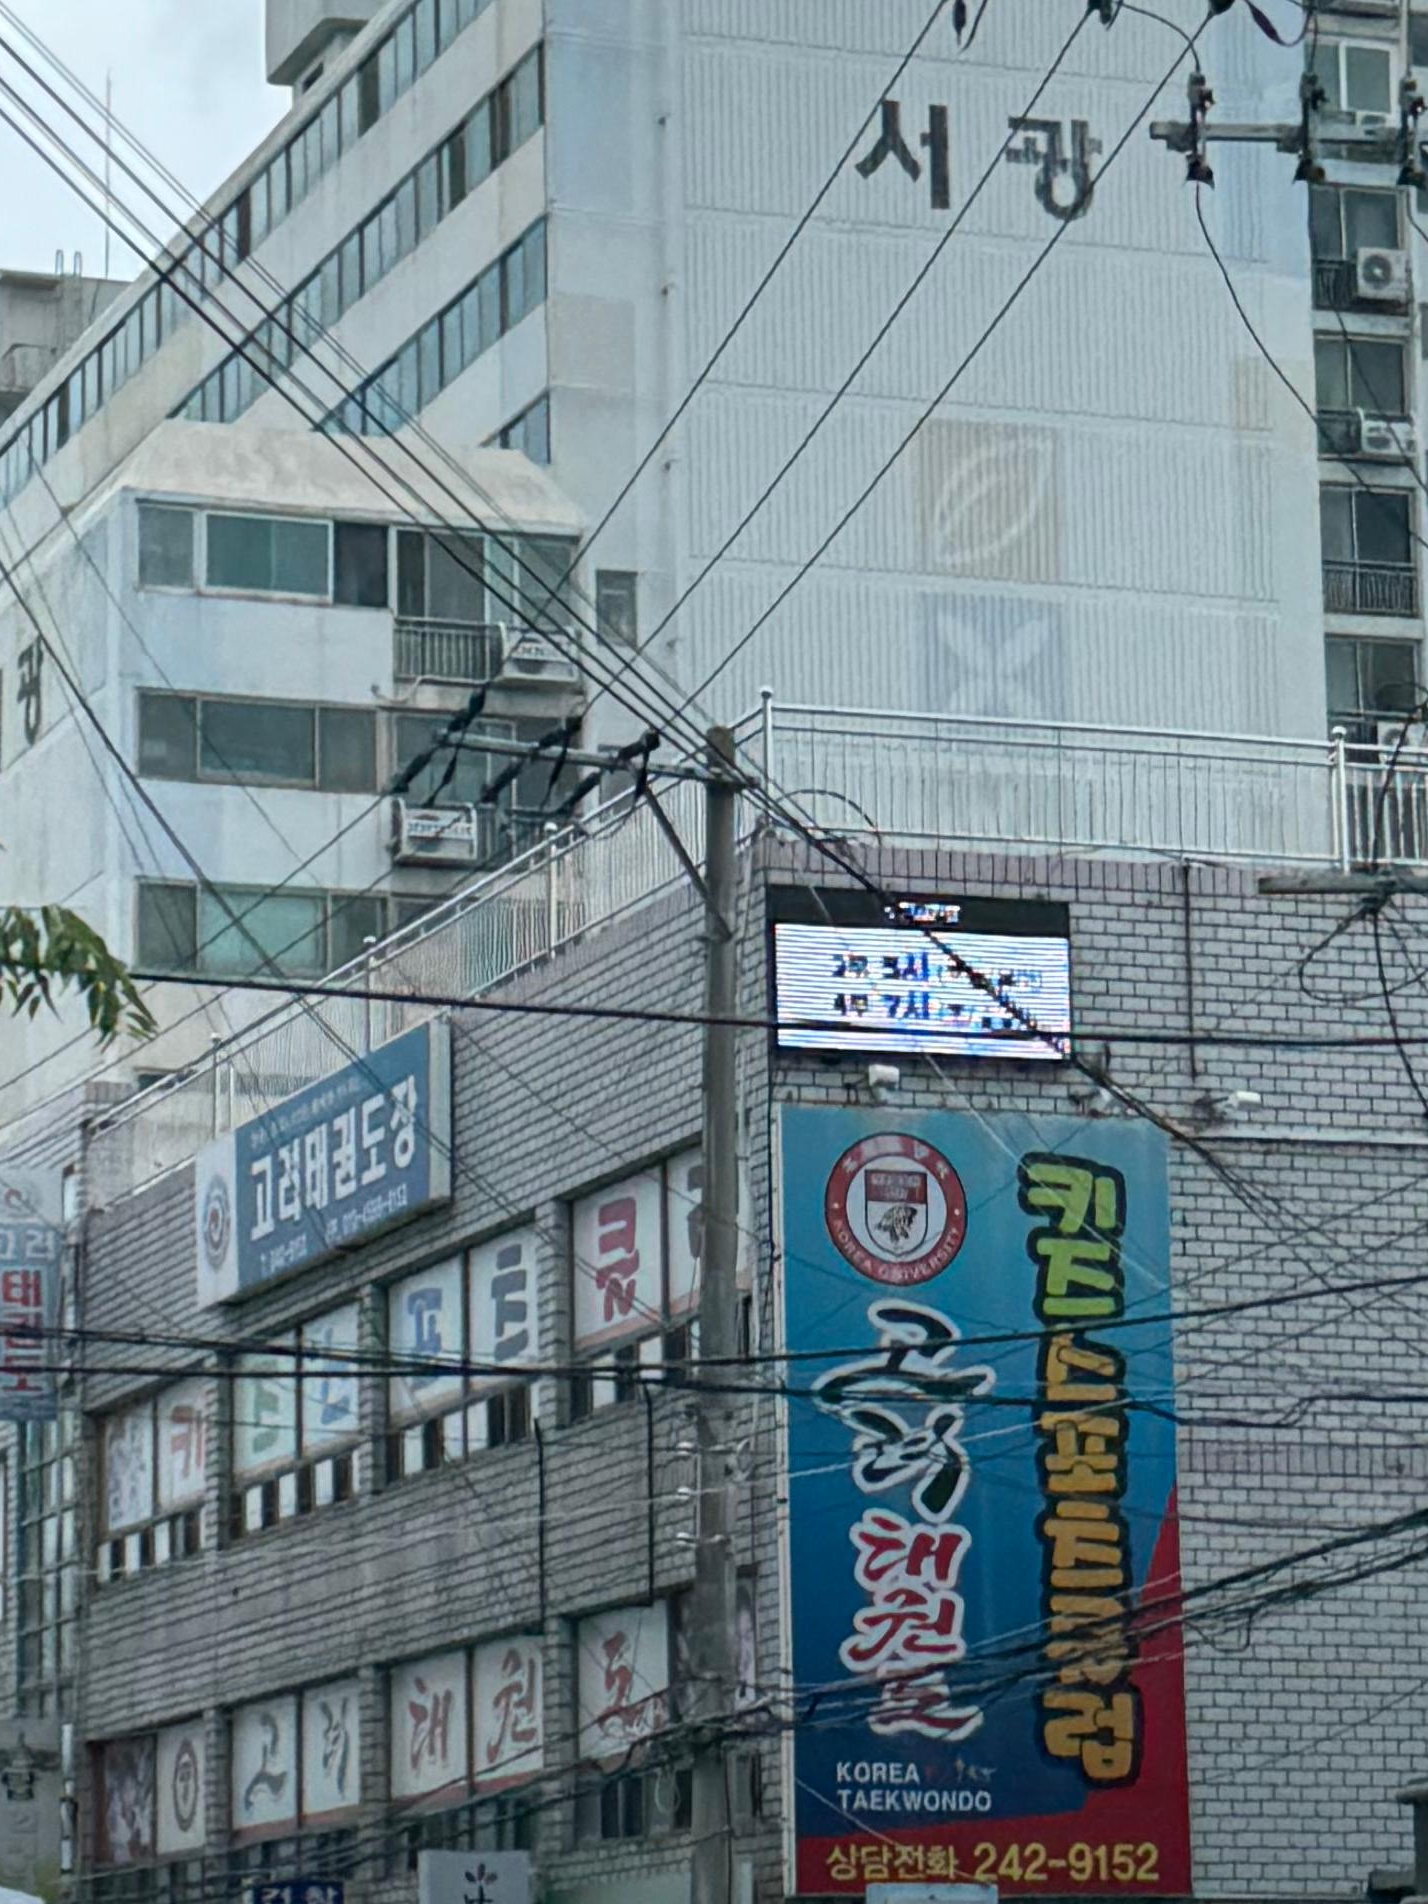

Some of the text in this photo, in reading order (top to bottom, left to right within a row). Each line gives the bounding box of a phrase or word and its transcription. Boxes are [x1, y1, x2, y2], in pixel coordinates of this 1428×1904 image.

[855, 99, 1103, 221] 서광
[250, 1074, 419, 1242] 고려태권도장
[836, 1761, 921, 1784] KOREA
[837, 1789, 992, 1812] TAEKWONDO
[825, 1842, 1160, 1882] 상담전화 242-9152
